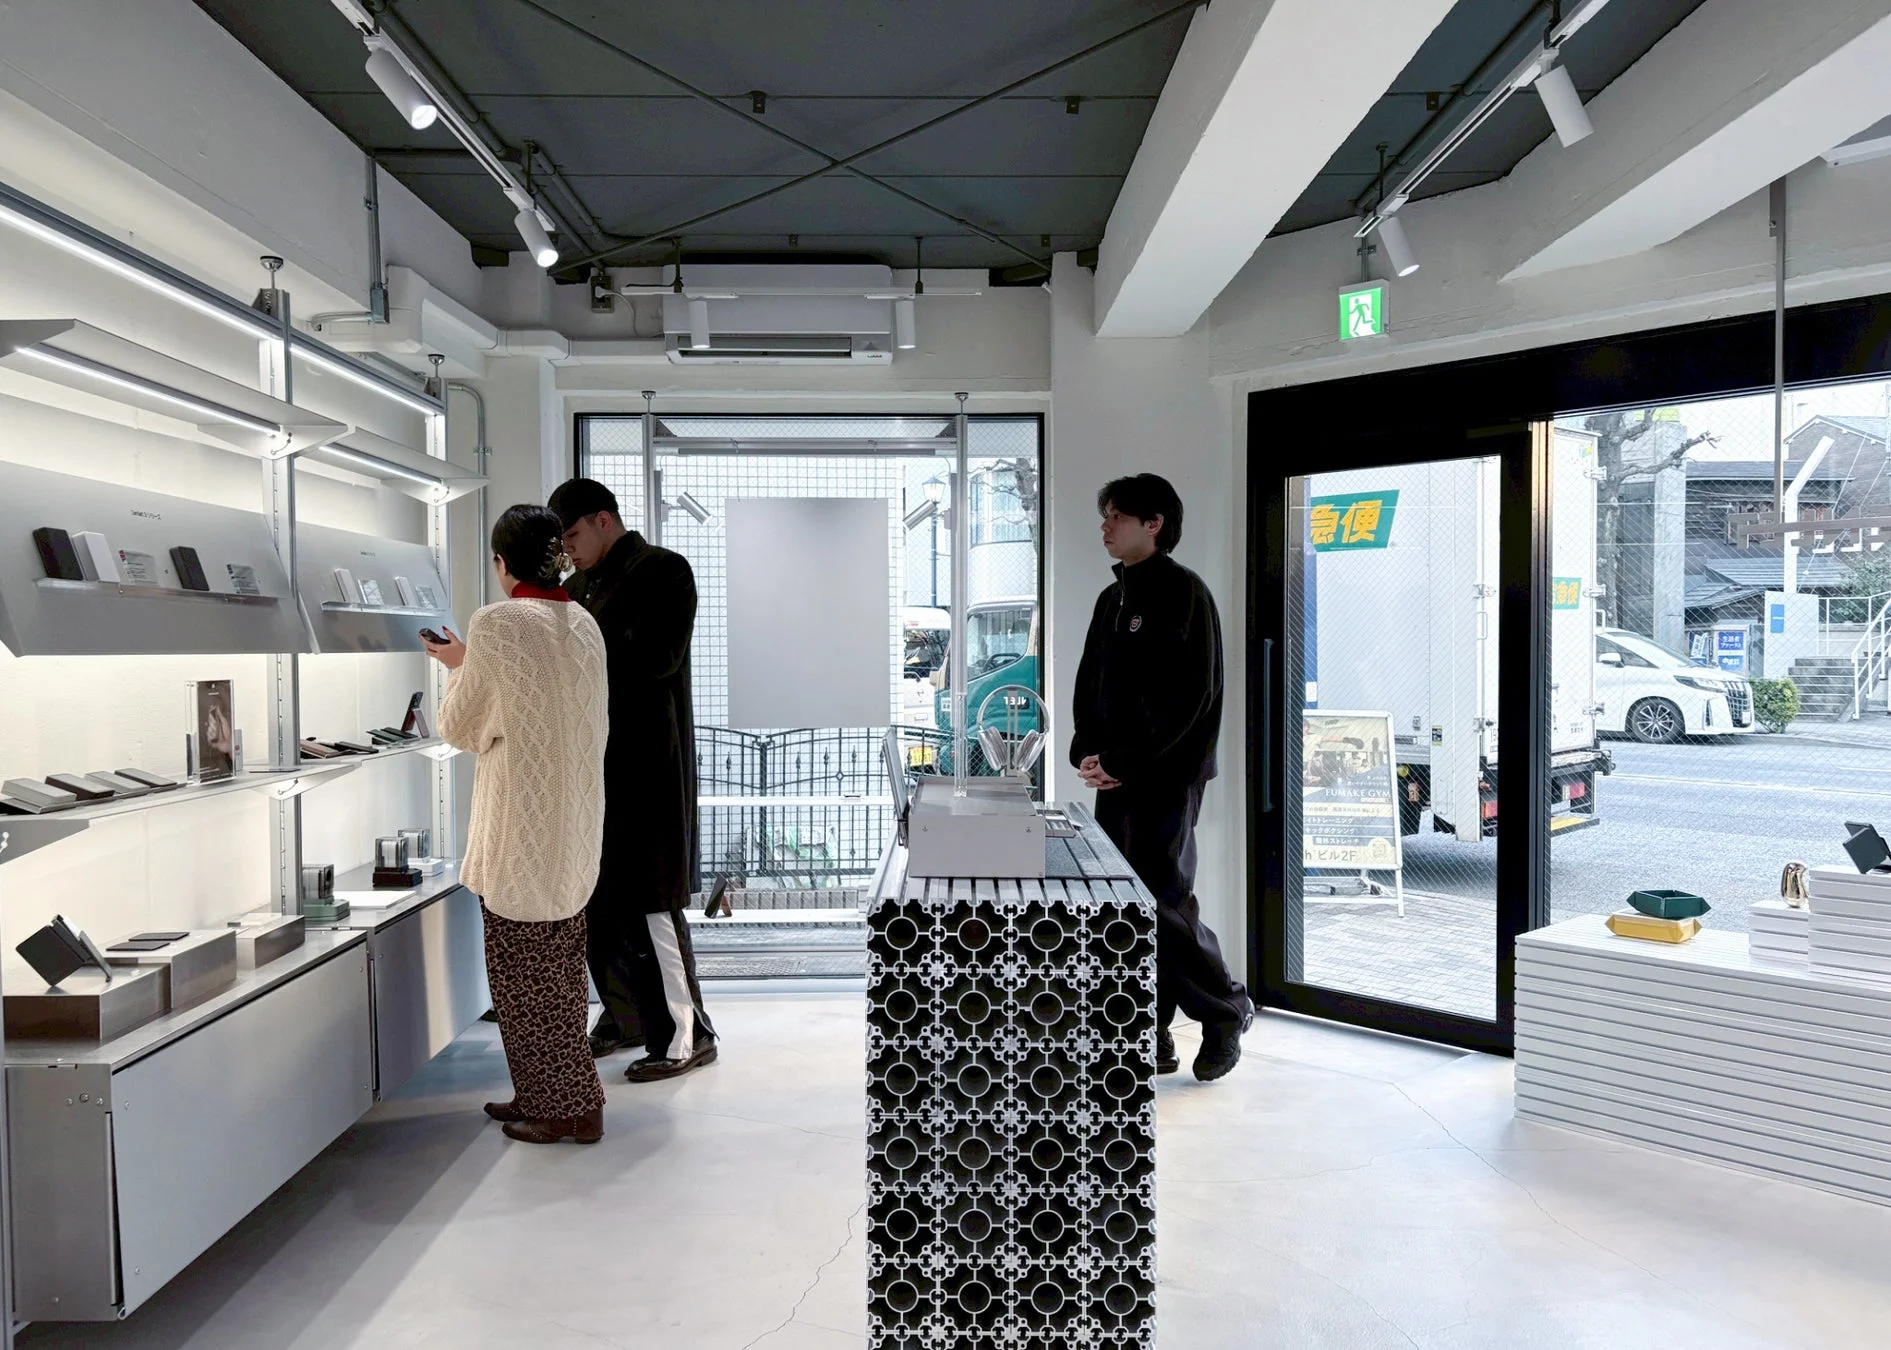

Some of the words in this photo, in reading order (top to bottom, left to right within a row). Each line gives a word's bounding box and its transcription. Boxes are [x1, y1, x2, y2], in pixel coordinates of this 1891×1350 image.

[1310, 500, 1383, 545] 急便
[1368, 788, 1390, 798] GYM
[1318, 850, 1356, 861] ビル2F
